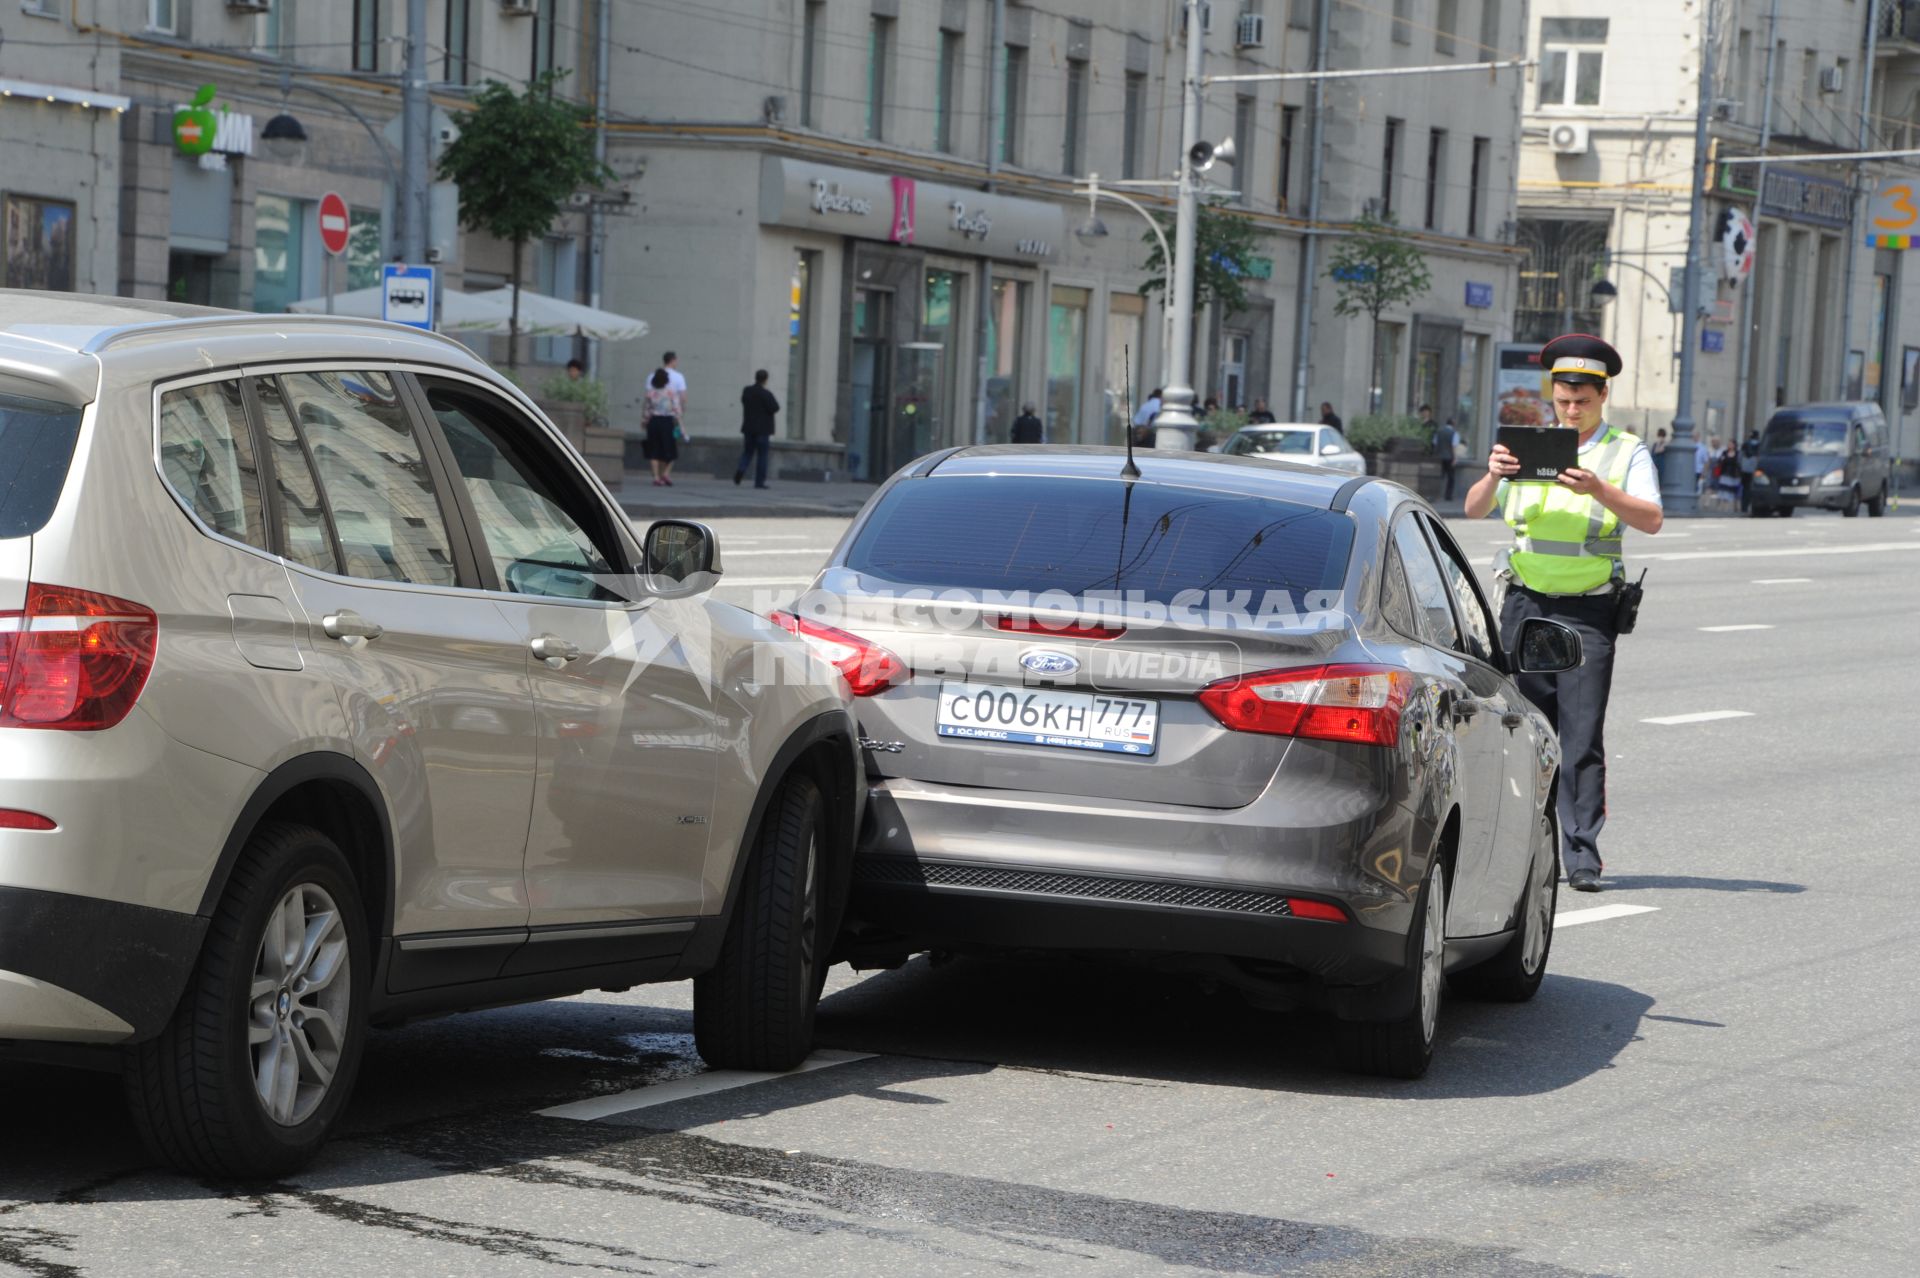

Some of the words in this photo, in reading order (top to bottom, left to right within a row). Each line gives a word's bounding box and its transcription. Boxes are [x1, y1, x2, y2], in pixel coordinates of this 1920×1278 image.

[1031, 655, 1067, 671] Ford
[1095, 698, 1147, 728] 777
[1104, 726, 1131, 738] RUS
